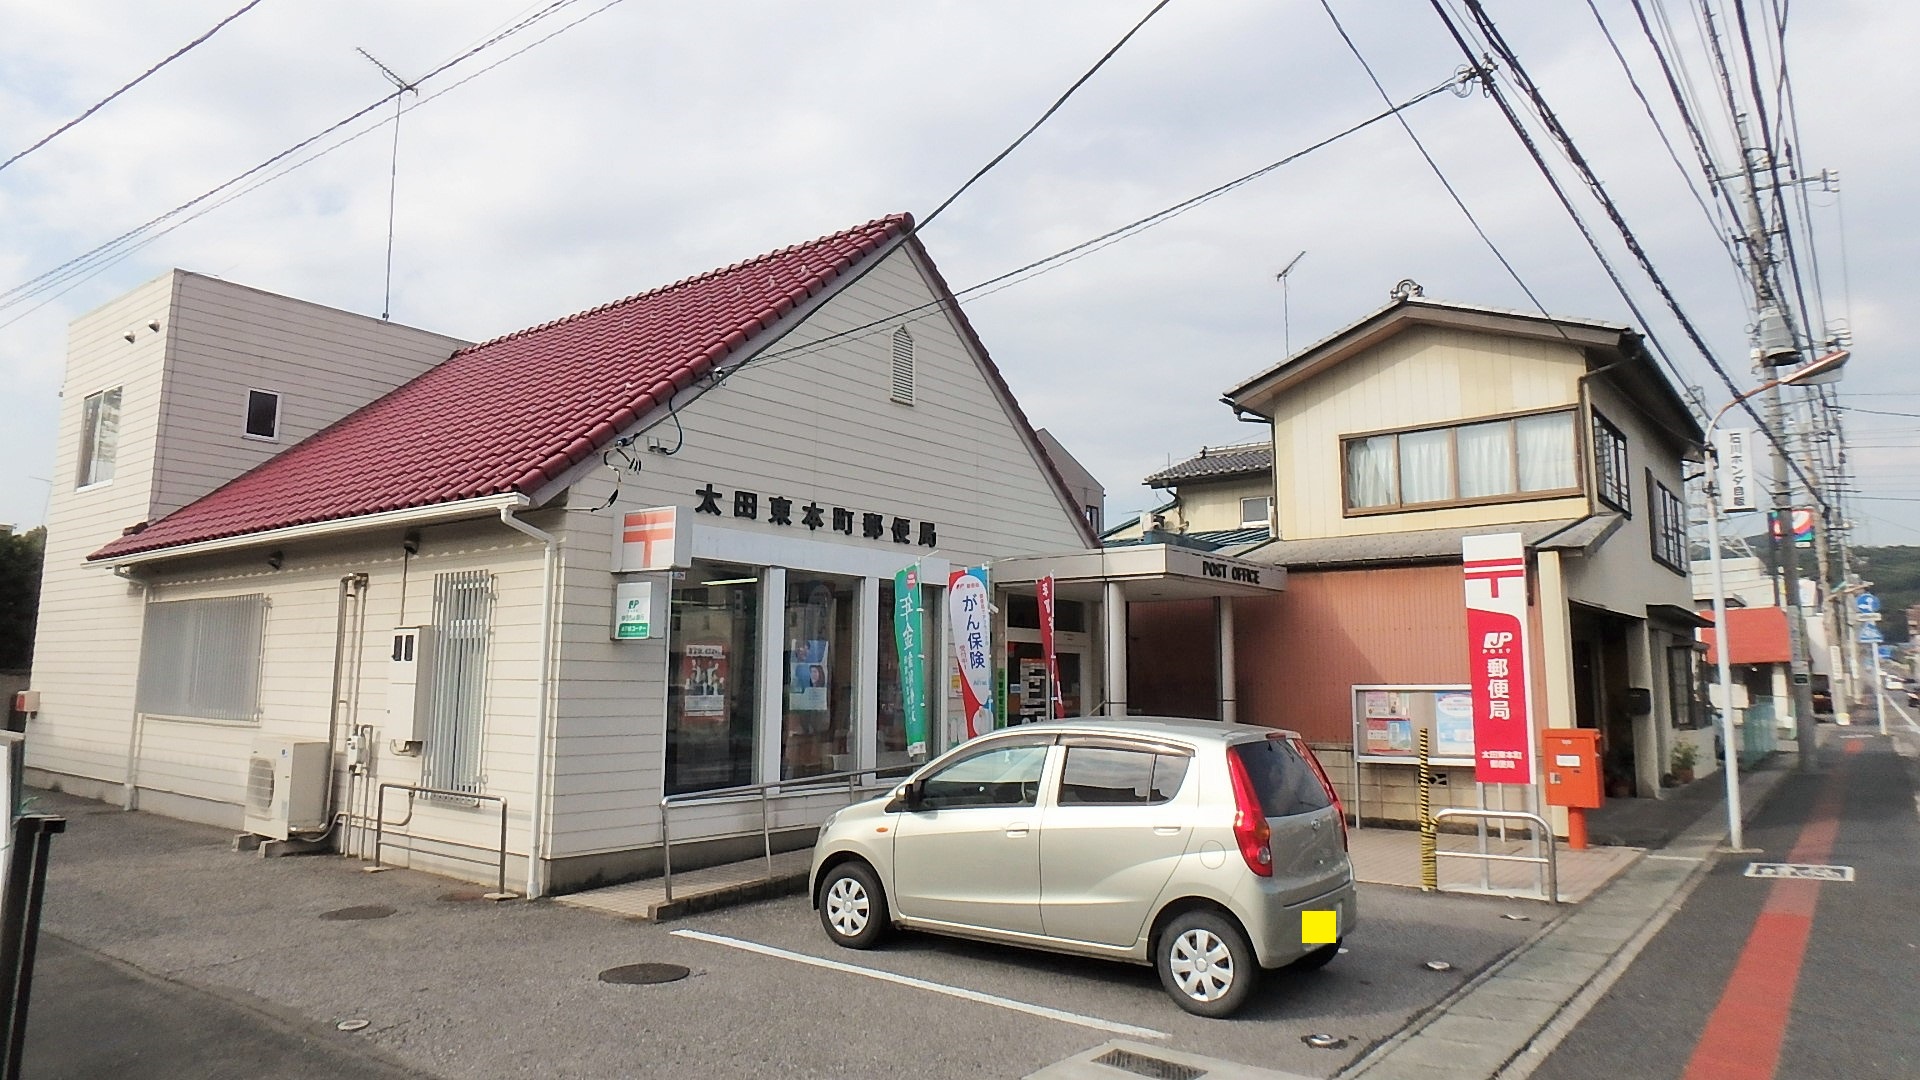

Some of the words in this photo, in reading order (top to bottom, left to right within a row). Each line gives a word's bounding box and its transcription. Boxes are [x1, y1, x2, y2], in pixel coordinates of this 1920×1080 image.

[694, 483, 937, 548] 太田東本町郵便局
[1202, 561, 1228, 579] POST
[1231, 566, 1260, 585] OFFICE
[962, 593, 986, 670] がん保険
[1487, 658, 1511, 720] 郵便局
